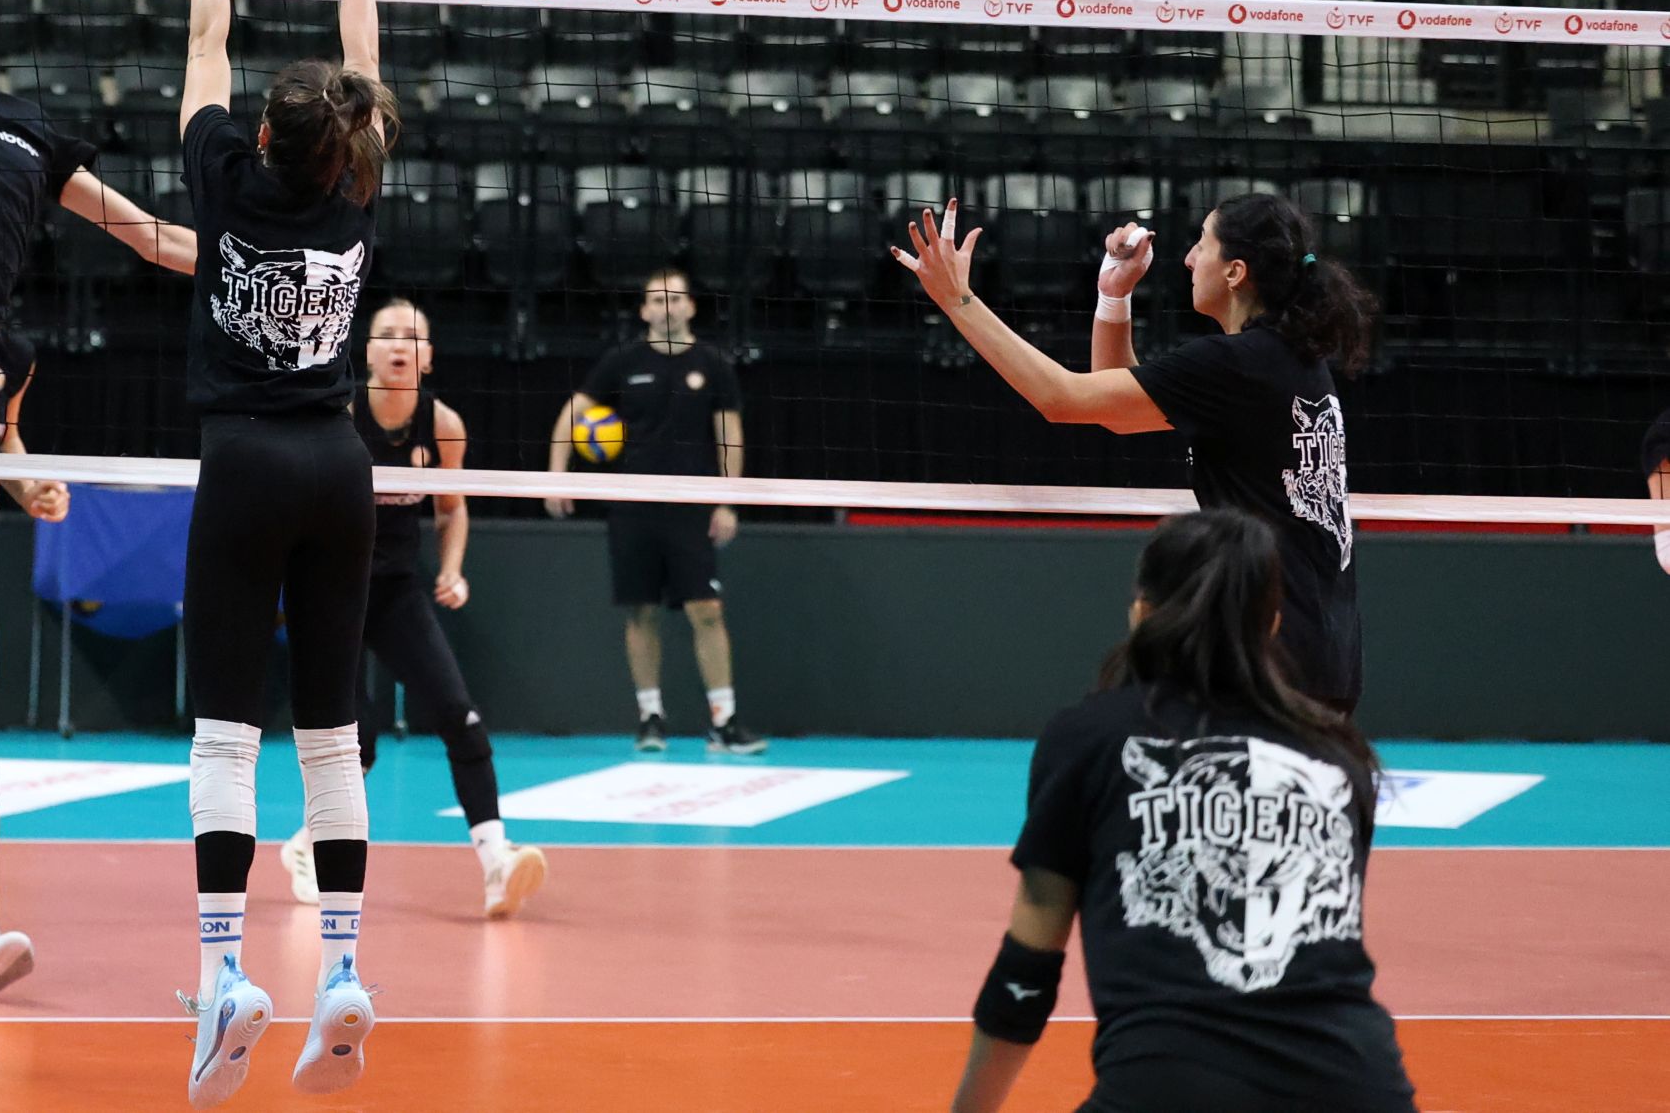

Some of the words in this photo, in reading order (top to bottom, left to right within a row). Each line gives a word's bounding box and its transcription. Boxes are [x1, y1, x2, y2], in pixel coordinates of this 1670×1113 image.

[1006, 3, 1033, 14] TVF
[1078, 3, 1133, 16] vodafone
[1178, 9, 1205, 21] TVF
[1249, 9, 1304, 22] vodafone
[1348, 15, 1374, 27] TVF
[1419, 14, 1472, 27] vodafone
[1516, 20, 1542, 31] TVF
[1586, 19, 1639, 32] vodafone
[1292, 430, 1346, 471] TIGE
[1128, 785, 1353, 864] TIGERS
